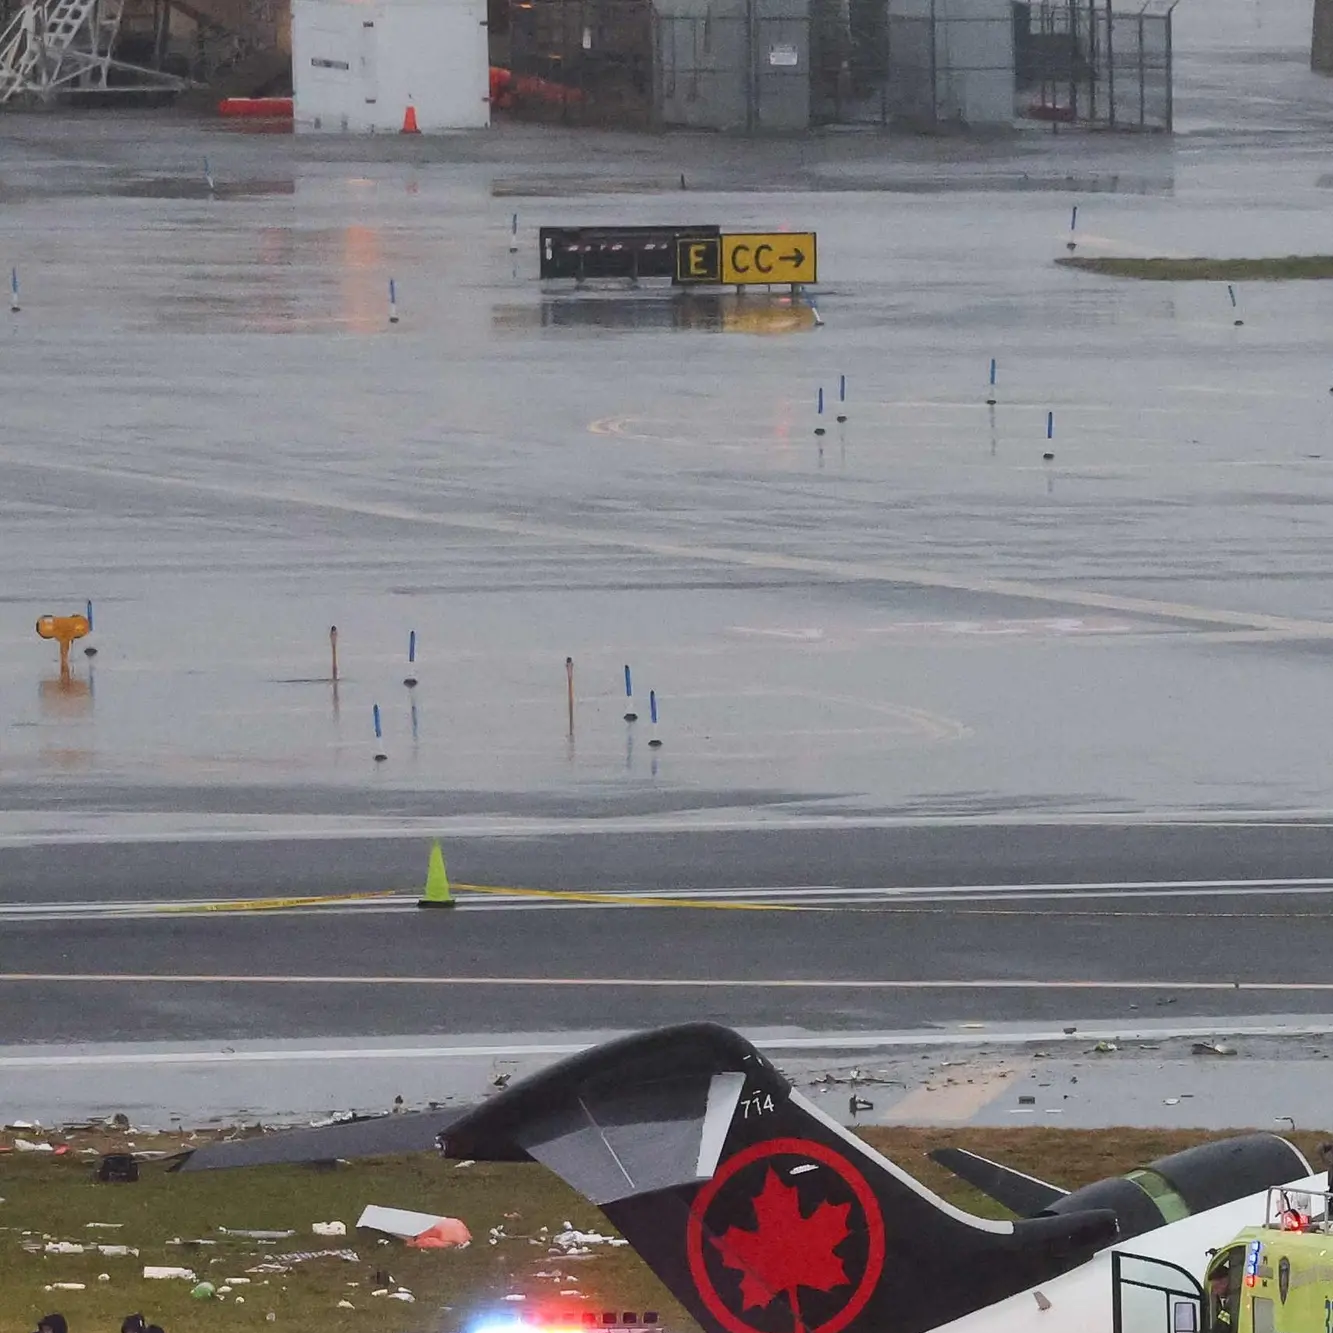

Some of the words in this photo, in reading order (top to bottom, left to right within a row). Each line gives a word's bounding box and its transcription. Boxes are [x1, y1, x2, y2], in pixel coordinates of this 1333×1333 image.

[689, 244, 708, 275] E
[732, 244, 773, 274] CC
[740, 1094, 775, 1118] 714
